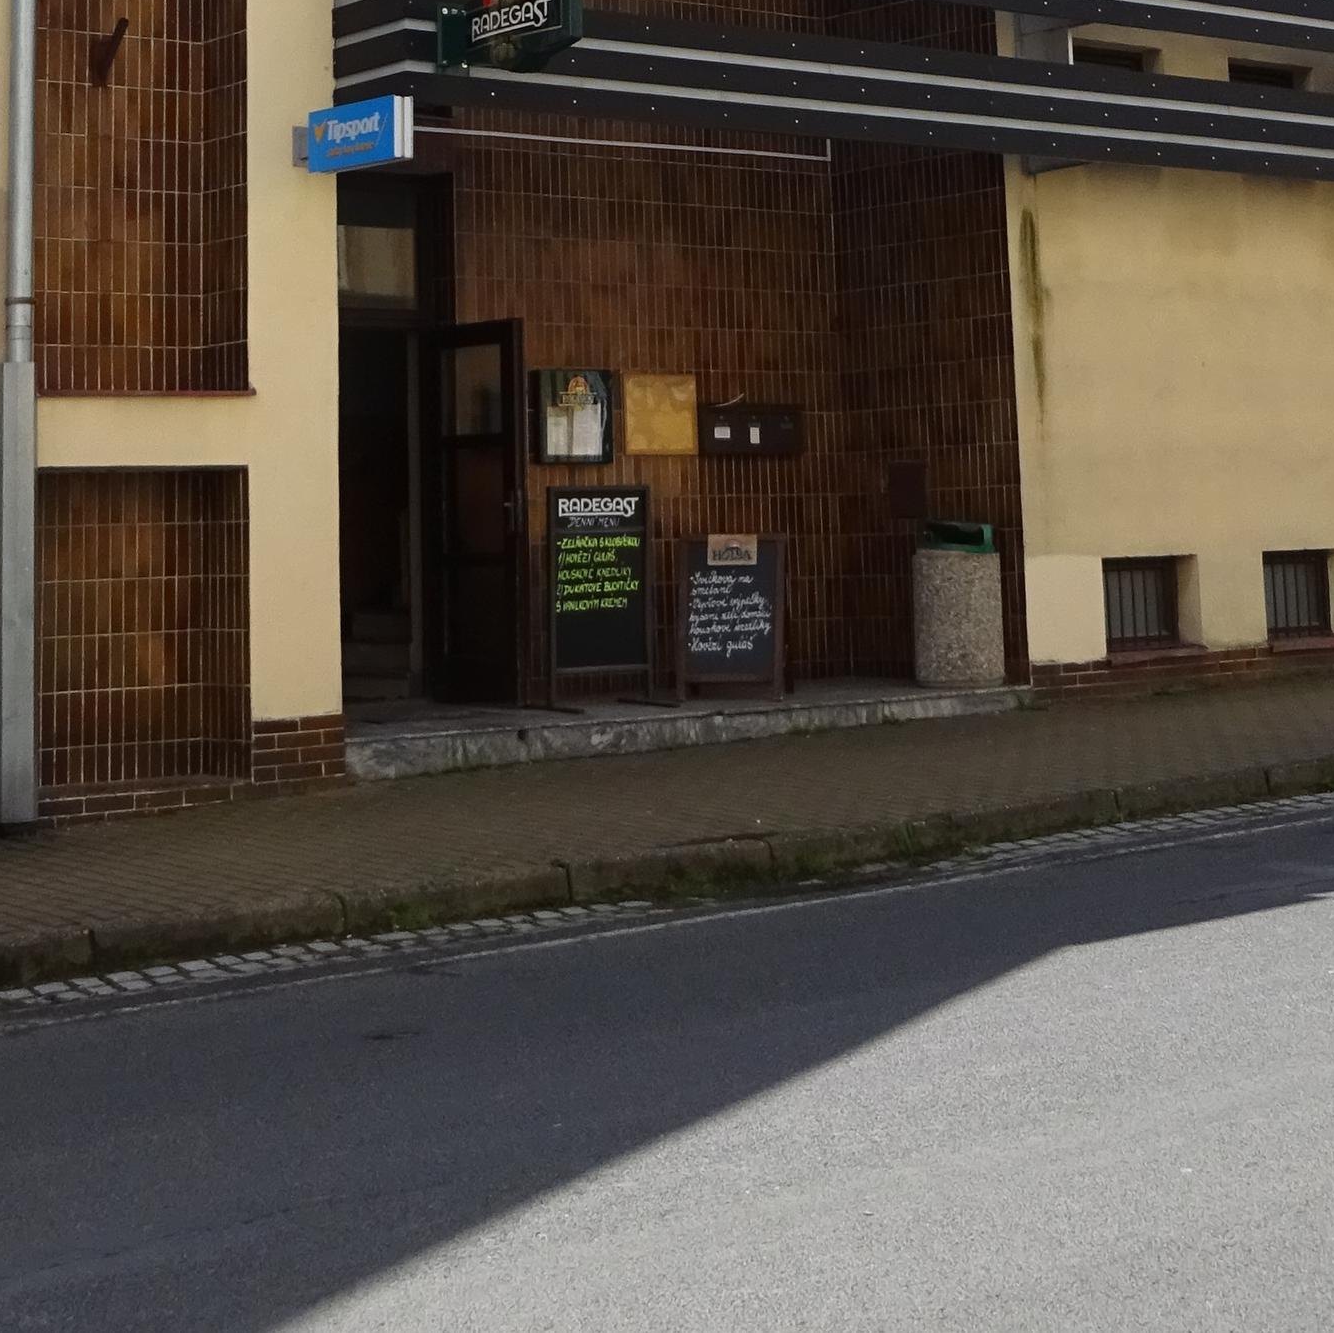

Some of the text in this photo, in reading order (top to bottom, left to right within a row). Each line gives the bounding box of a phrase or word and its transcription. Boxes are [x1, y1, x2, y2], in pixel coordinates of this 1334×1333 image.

[327, 111, 381, 144] Tipsport
[558, 497, 639, 517] RADEGAST
[598, 516, 620, 527] MENU
